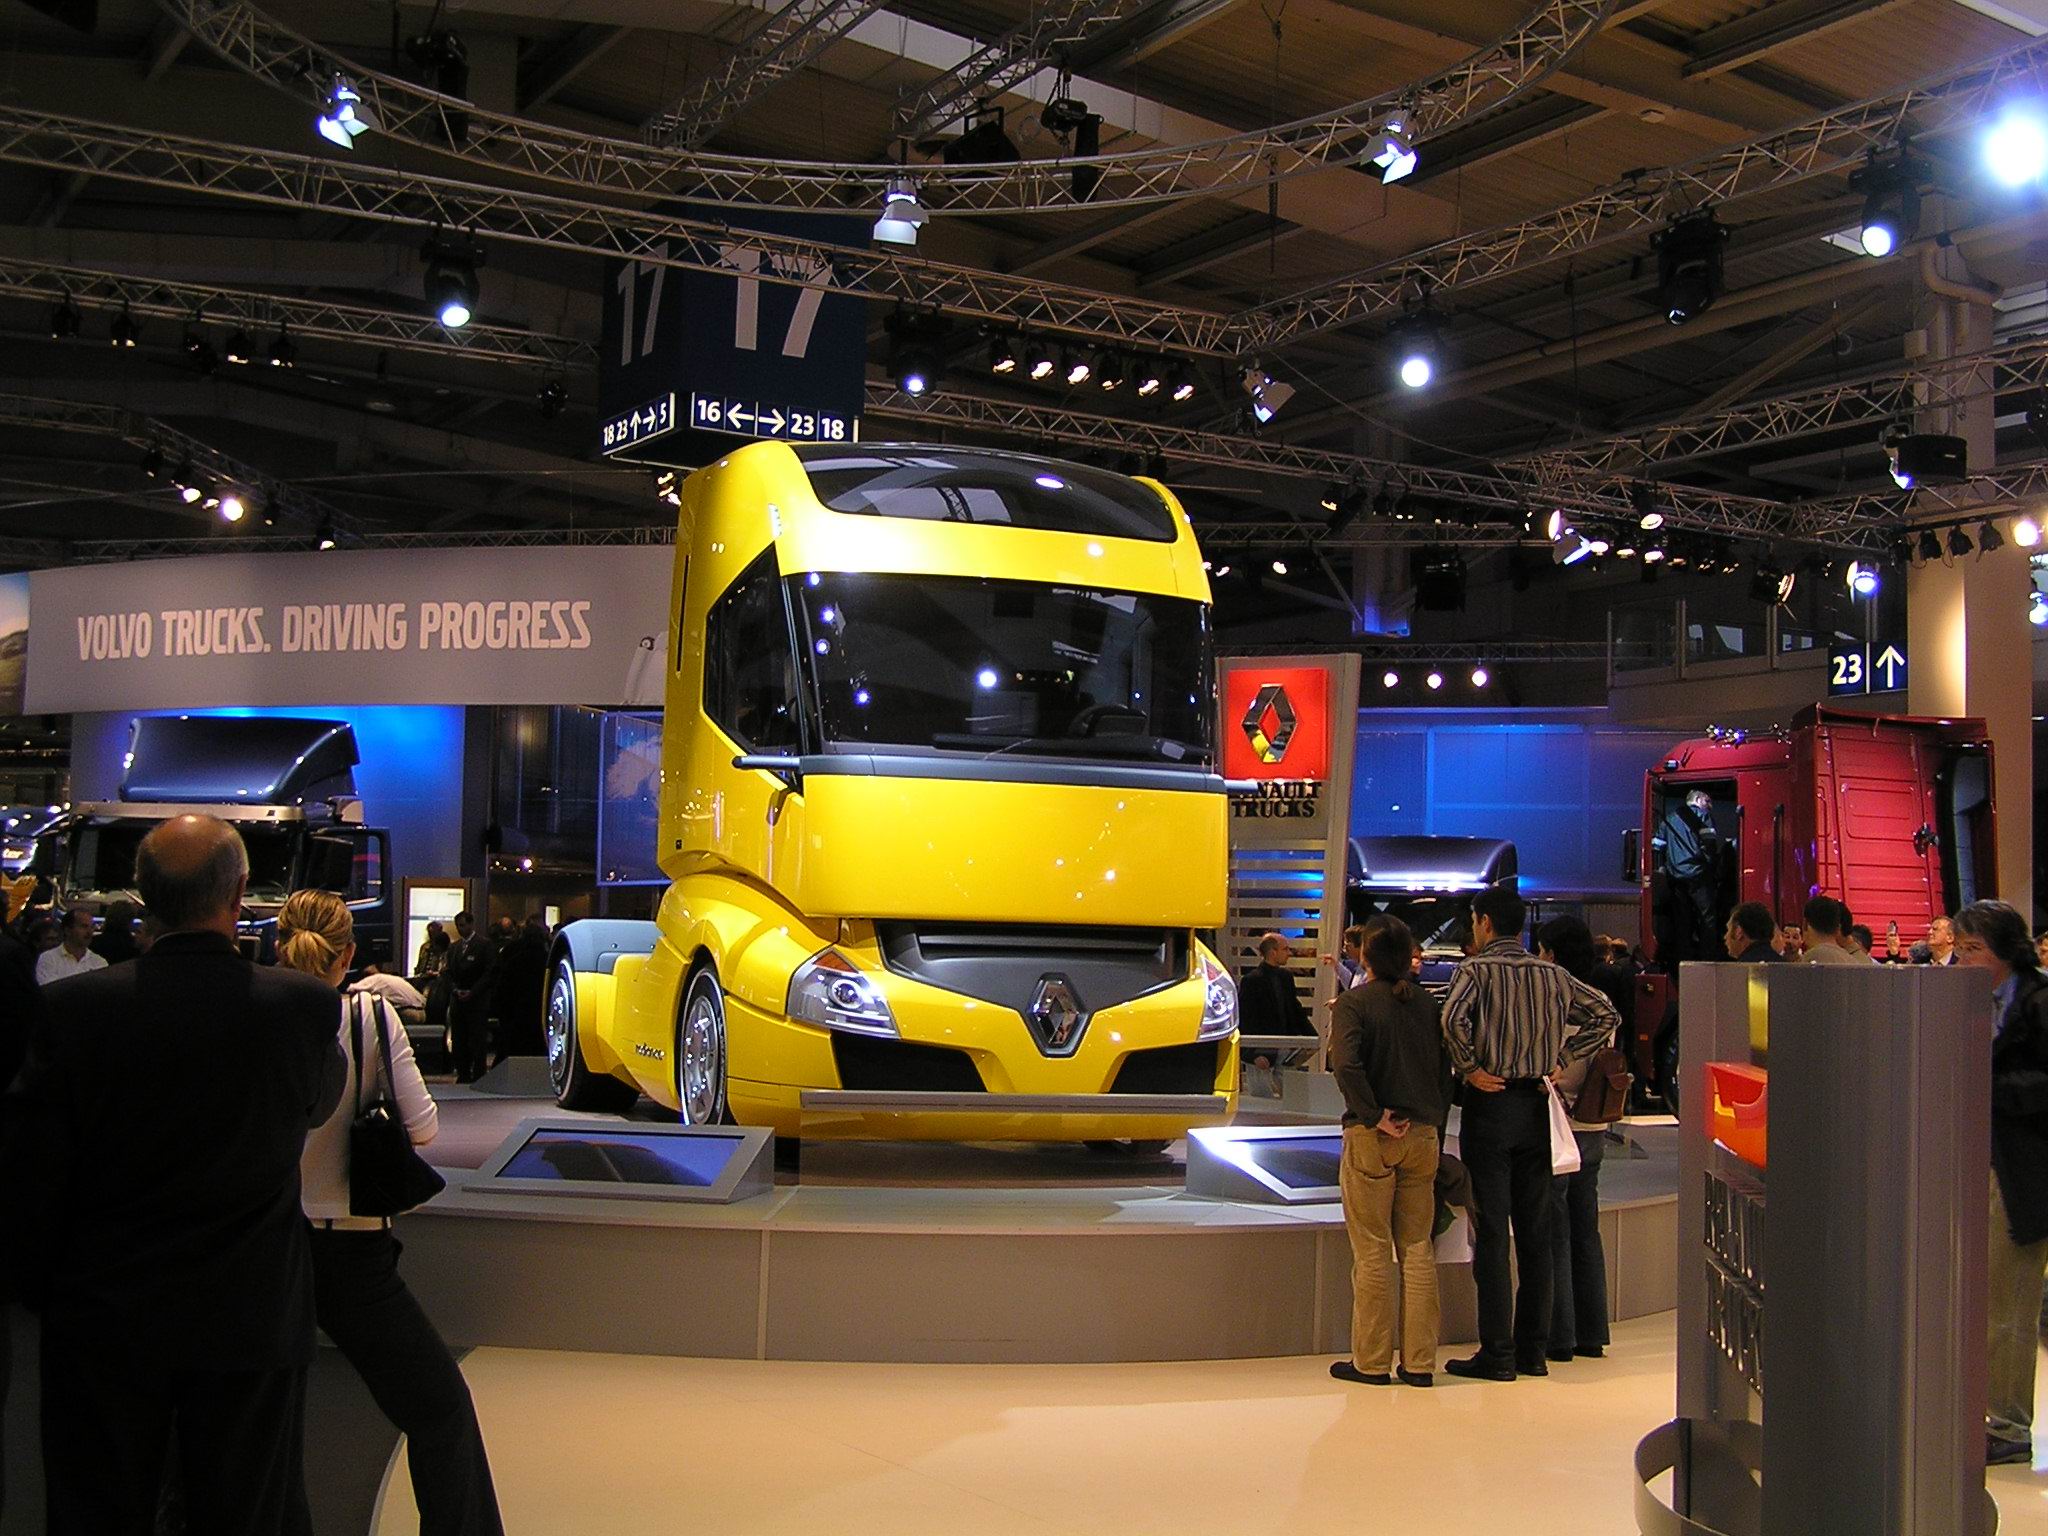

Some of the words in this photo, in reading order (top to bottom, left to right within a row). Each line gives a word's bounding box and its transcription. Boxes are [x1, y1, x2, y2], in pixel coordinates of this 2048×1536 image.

[719, 245, 833, 359] 17
[603, 424, 615, 446] 18
[616, 418, 628, 442] 23
[660, 402, 667, 424] 5
[698, 399, 721, 423] 16
[791, 413, 815, 436] 23
[821, 418, 845, 440] 18
[78, 611, 152, 661] VOLVO
[161, 607, 271, 657] TRUCKS.
[282, 603, 406, 652] DRIVING
[418, 601, 592, 650] PROGRESS
[1832, 653, 1863, 685] 23
[1229, 782, 1322, 799] NAULT
[1231, 800, 1315, 818] TRUCKS
